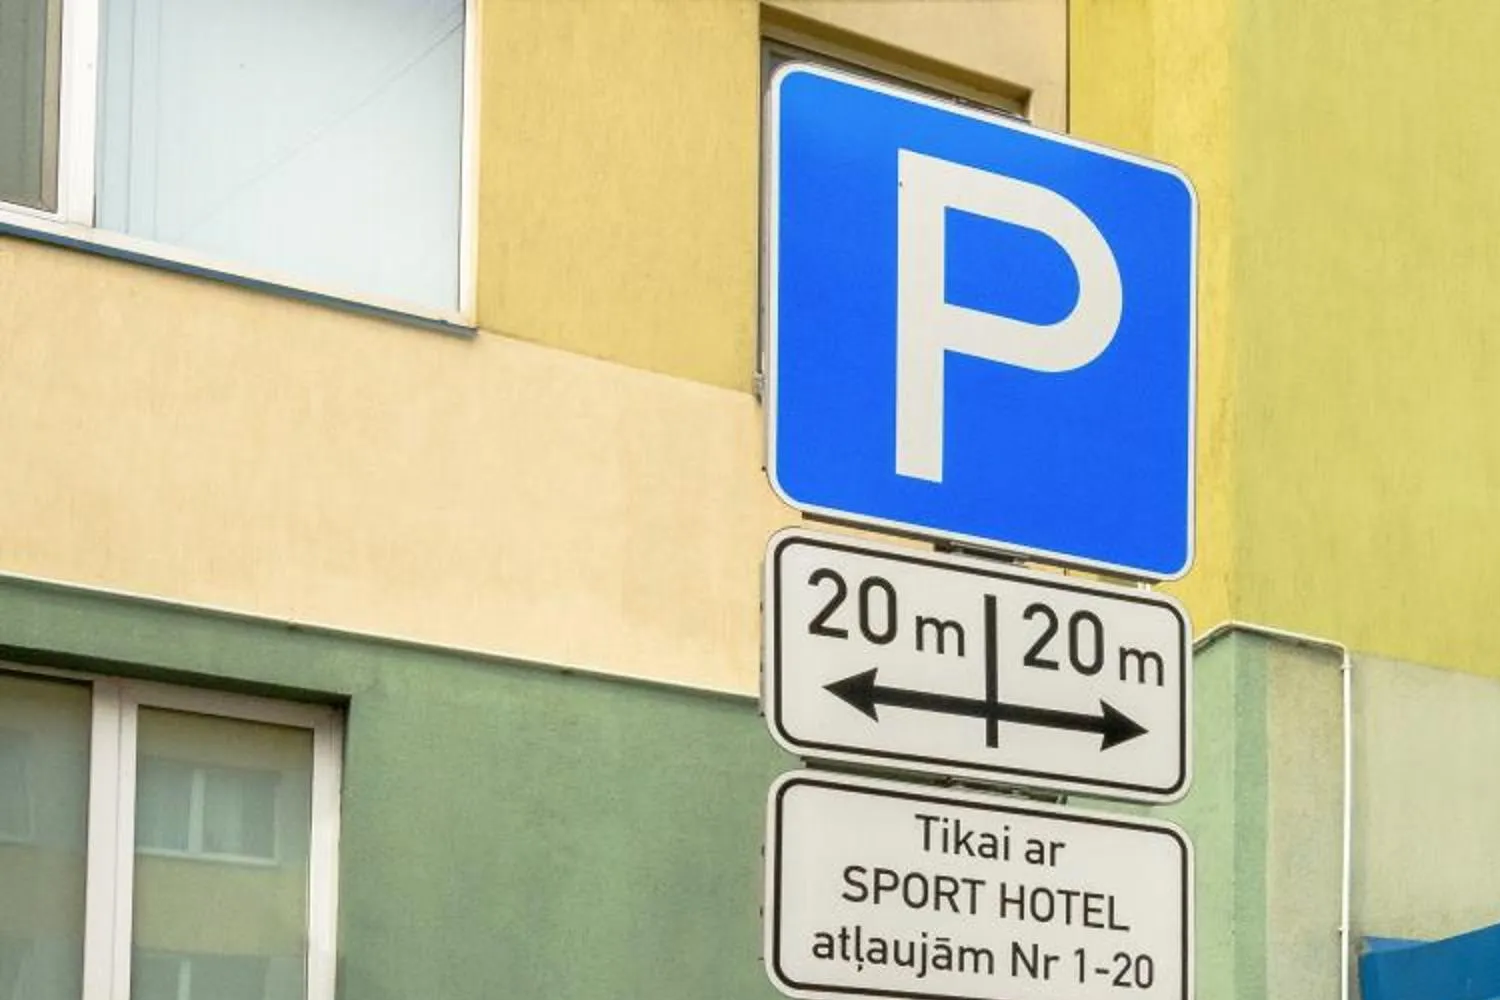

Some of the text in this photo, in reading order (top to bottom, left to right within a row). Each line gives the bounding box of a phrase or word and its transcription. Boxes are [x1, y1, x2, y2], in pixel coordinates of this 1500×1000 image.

[896, 148, 1123, 483] P
[807, 567, 965, 658] 20 m
[1022, 602, 1164, 687] 20 m
[914, 813, 1066, 867] Tikai ar
[841, 865, 1130, 932] SPORT HOTEL
[811, 925, 1154, 990] atļaujām Nr 1-20
